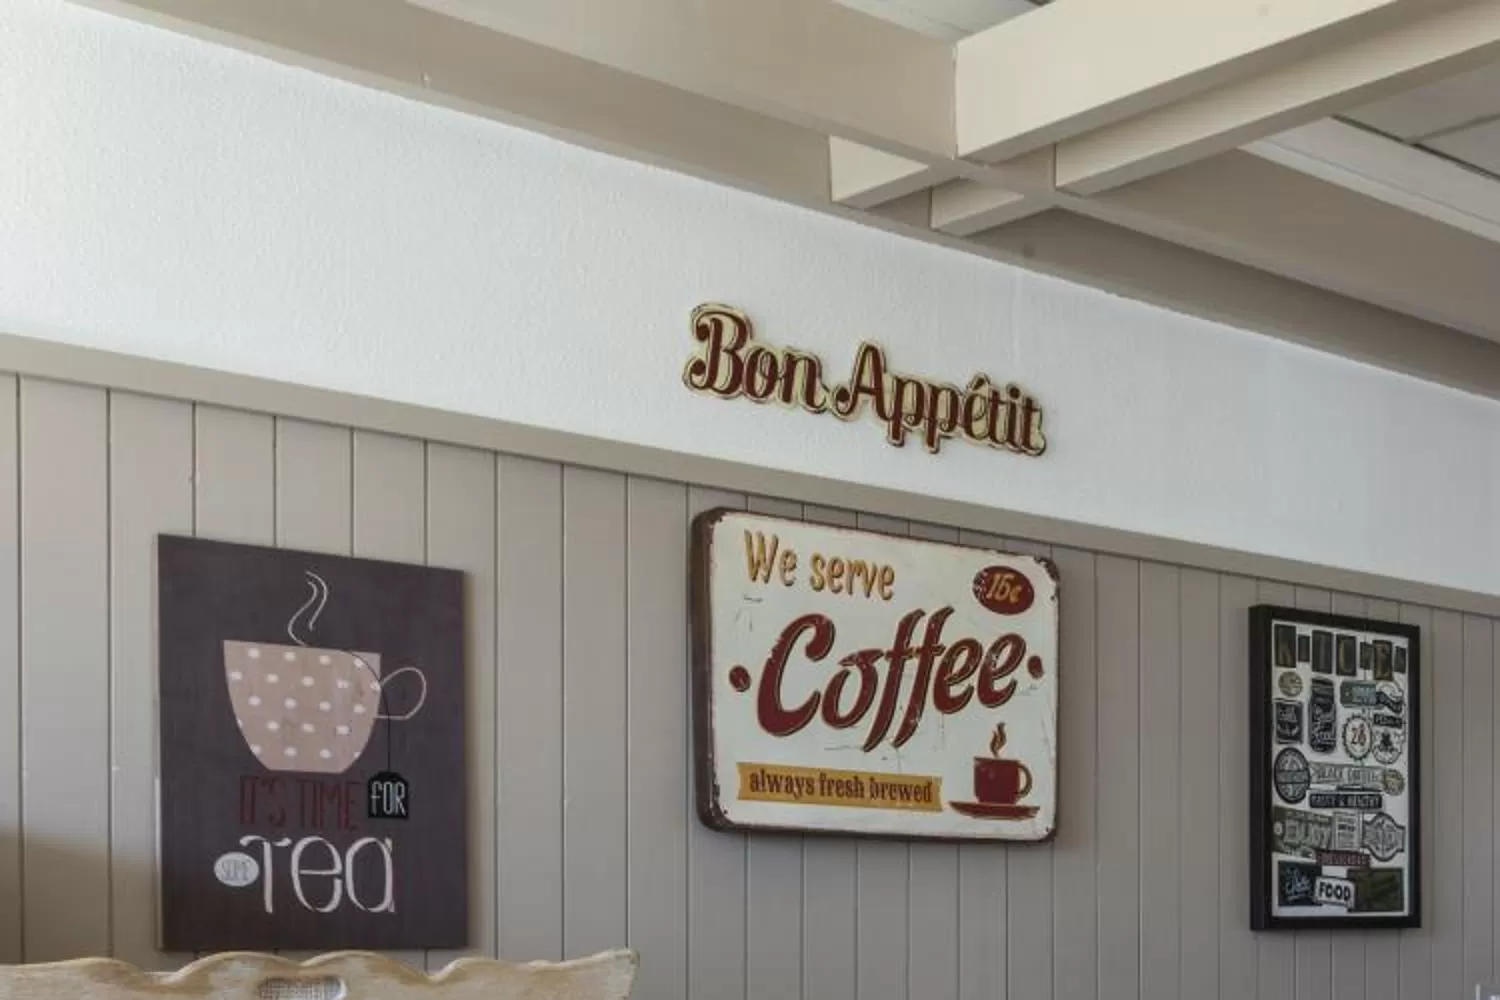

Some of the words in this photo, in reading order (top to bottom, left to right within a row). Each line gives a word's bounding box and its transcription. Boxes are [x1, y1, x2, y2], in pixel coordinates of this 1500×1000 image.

[683, 303, 826, 413] Bon
[830, 340, 1046, 456] Appétit
[744, 530, 796, 584] We
[809, 553, 895, 600] serve
[756, 606, 1027, 752] Coffee
[750, 768, 815, 799] always
[819, 772, 865, 798] fresh
[869, 776, 933, 803] brewed
[1319, 881, 1351, 901] FOOD
